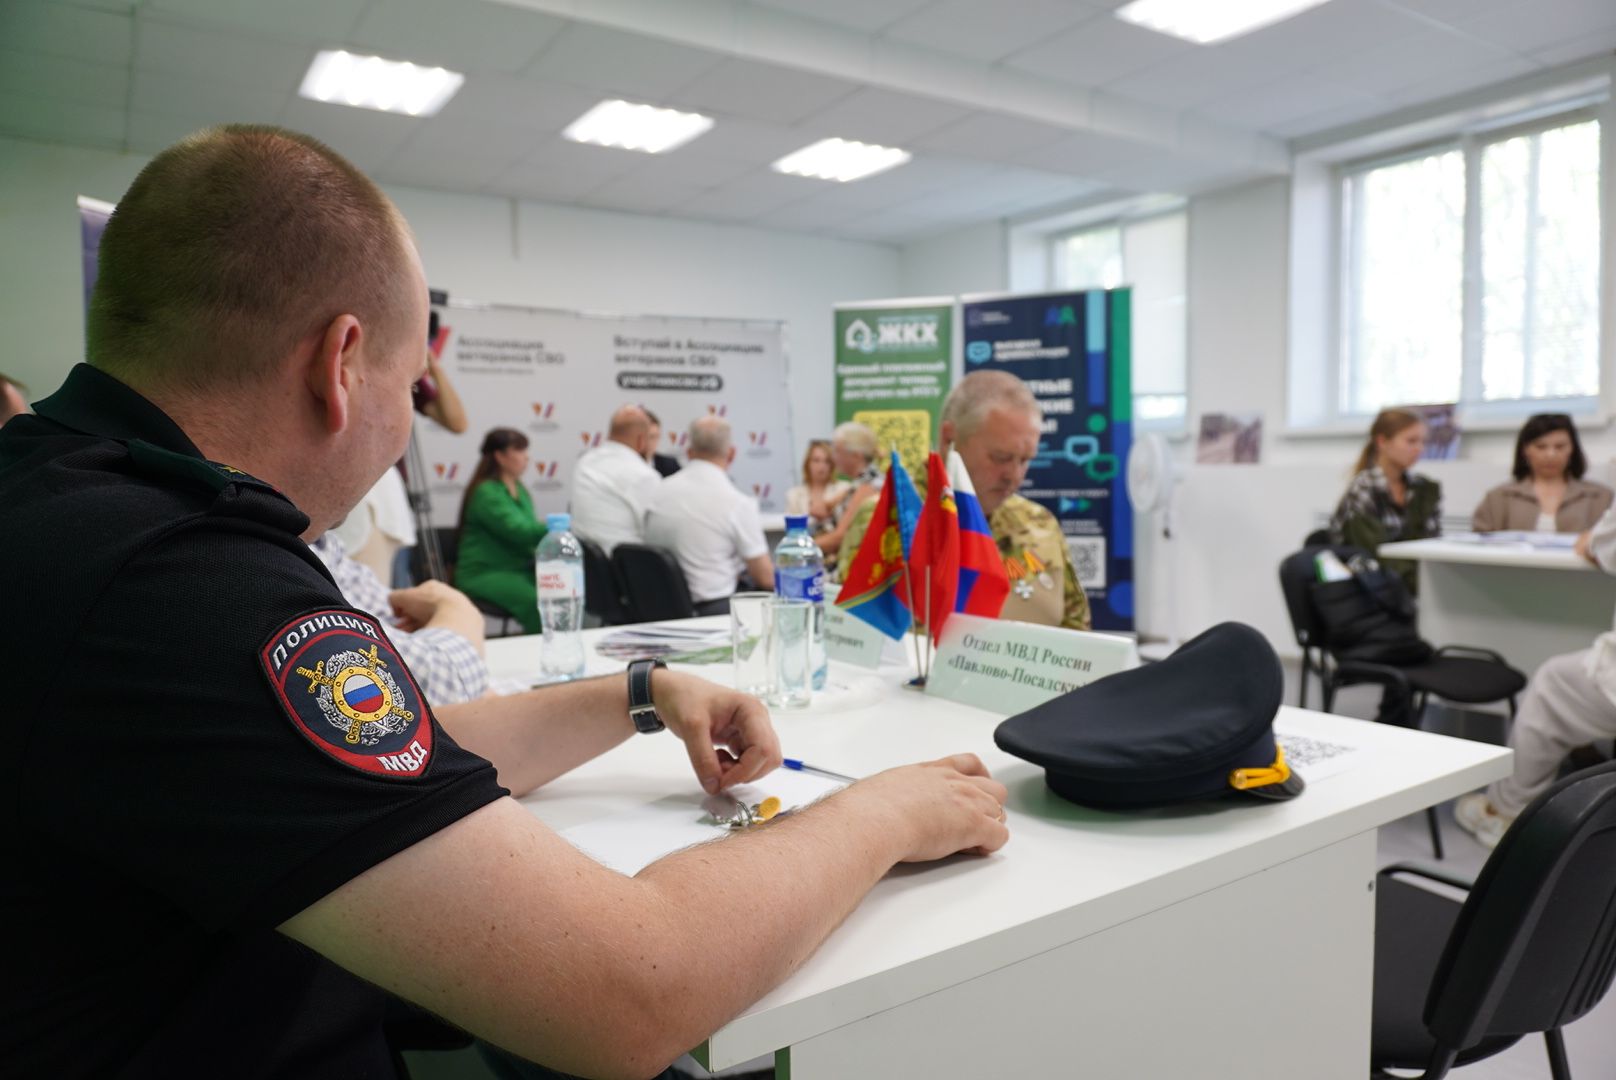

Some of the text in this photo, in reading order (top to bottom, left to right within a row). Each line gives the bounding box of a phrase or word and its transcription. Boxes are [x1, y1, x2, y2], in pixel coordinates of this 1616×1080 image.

[457, 335, 544, 350] Ассоциация
[613, 335, 671, 350] Вступай
[686, 338, 764, 353] Ассоциацию
[879, 323, 938, 345] ЖКХ
[457, 352, 565, 365] ветеранов СВО
[614, 354, 717, 367] ветеранов СВО
[272, 615, 380, 670] ПОЛИЦИЯ
[962, 633, 1093, 673] Отдел МВД России
[948, 653, 1089, 695] «Павлово-Посадски
[376, 740, 427, 772] МВД
